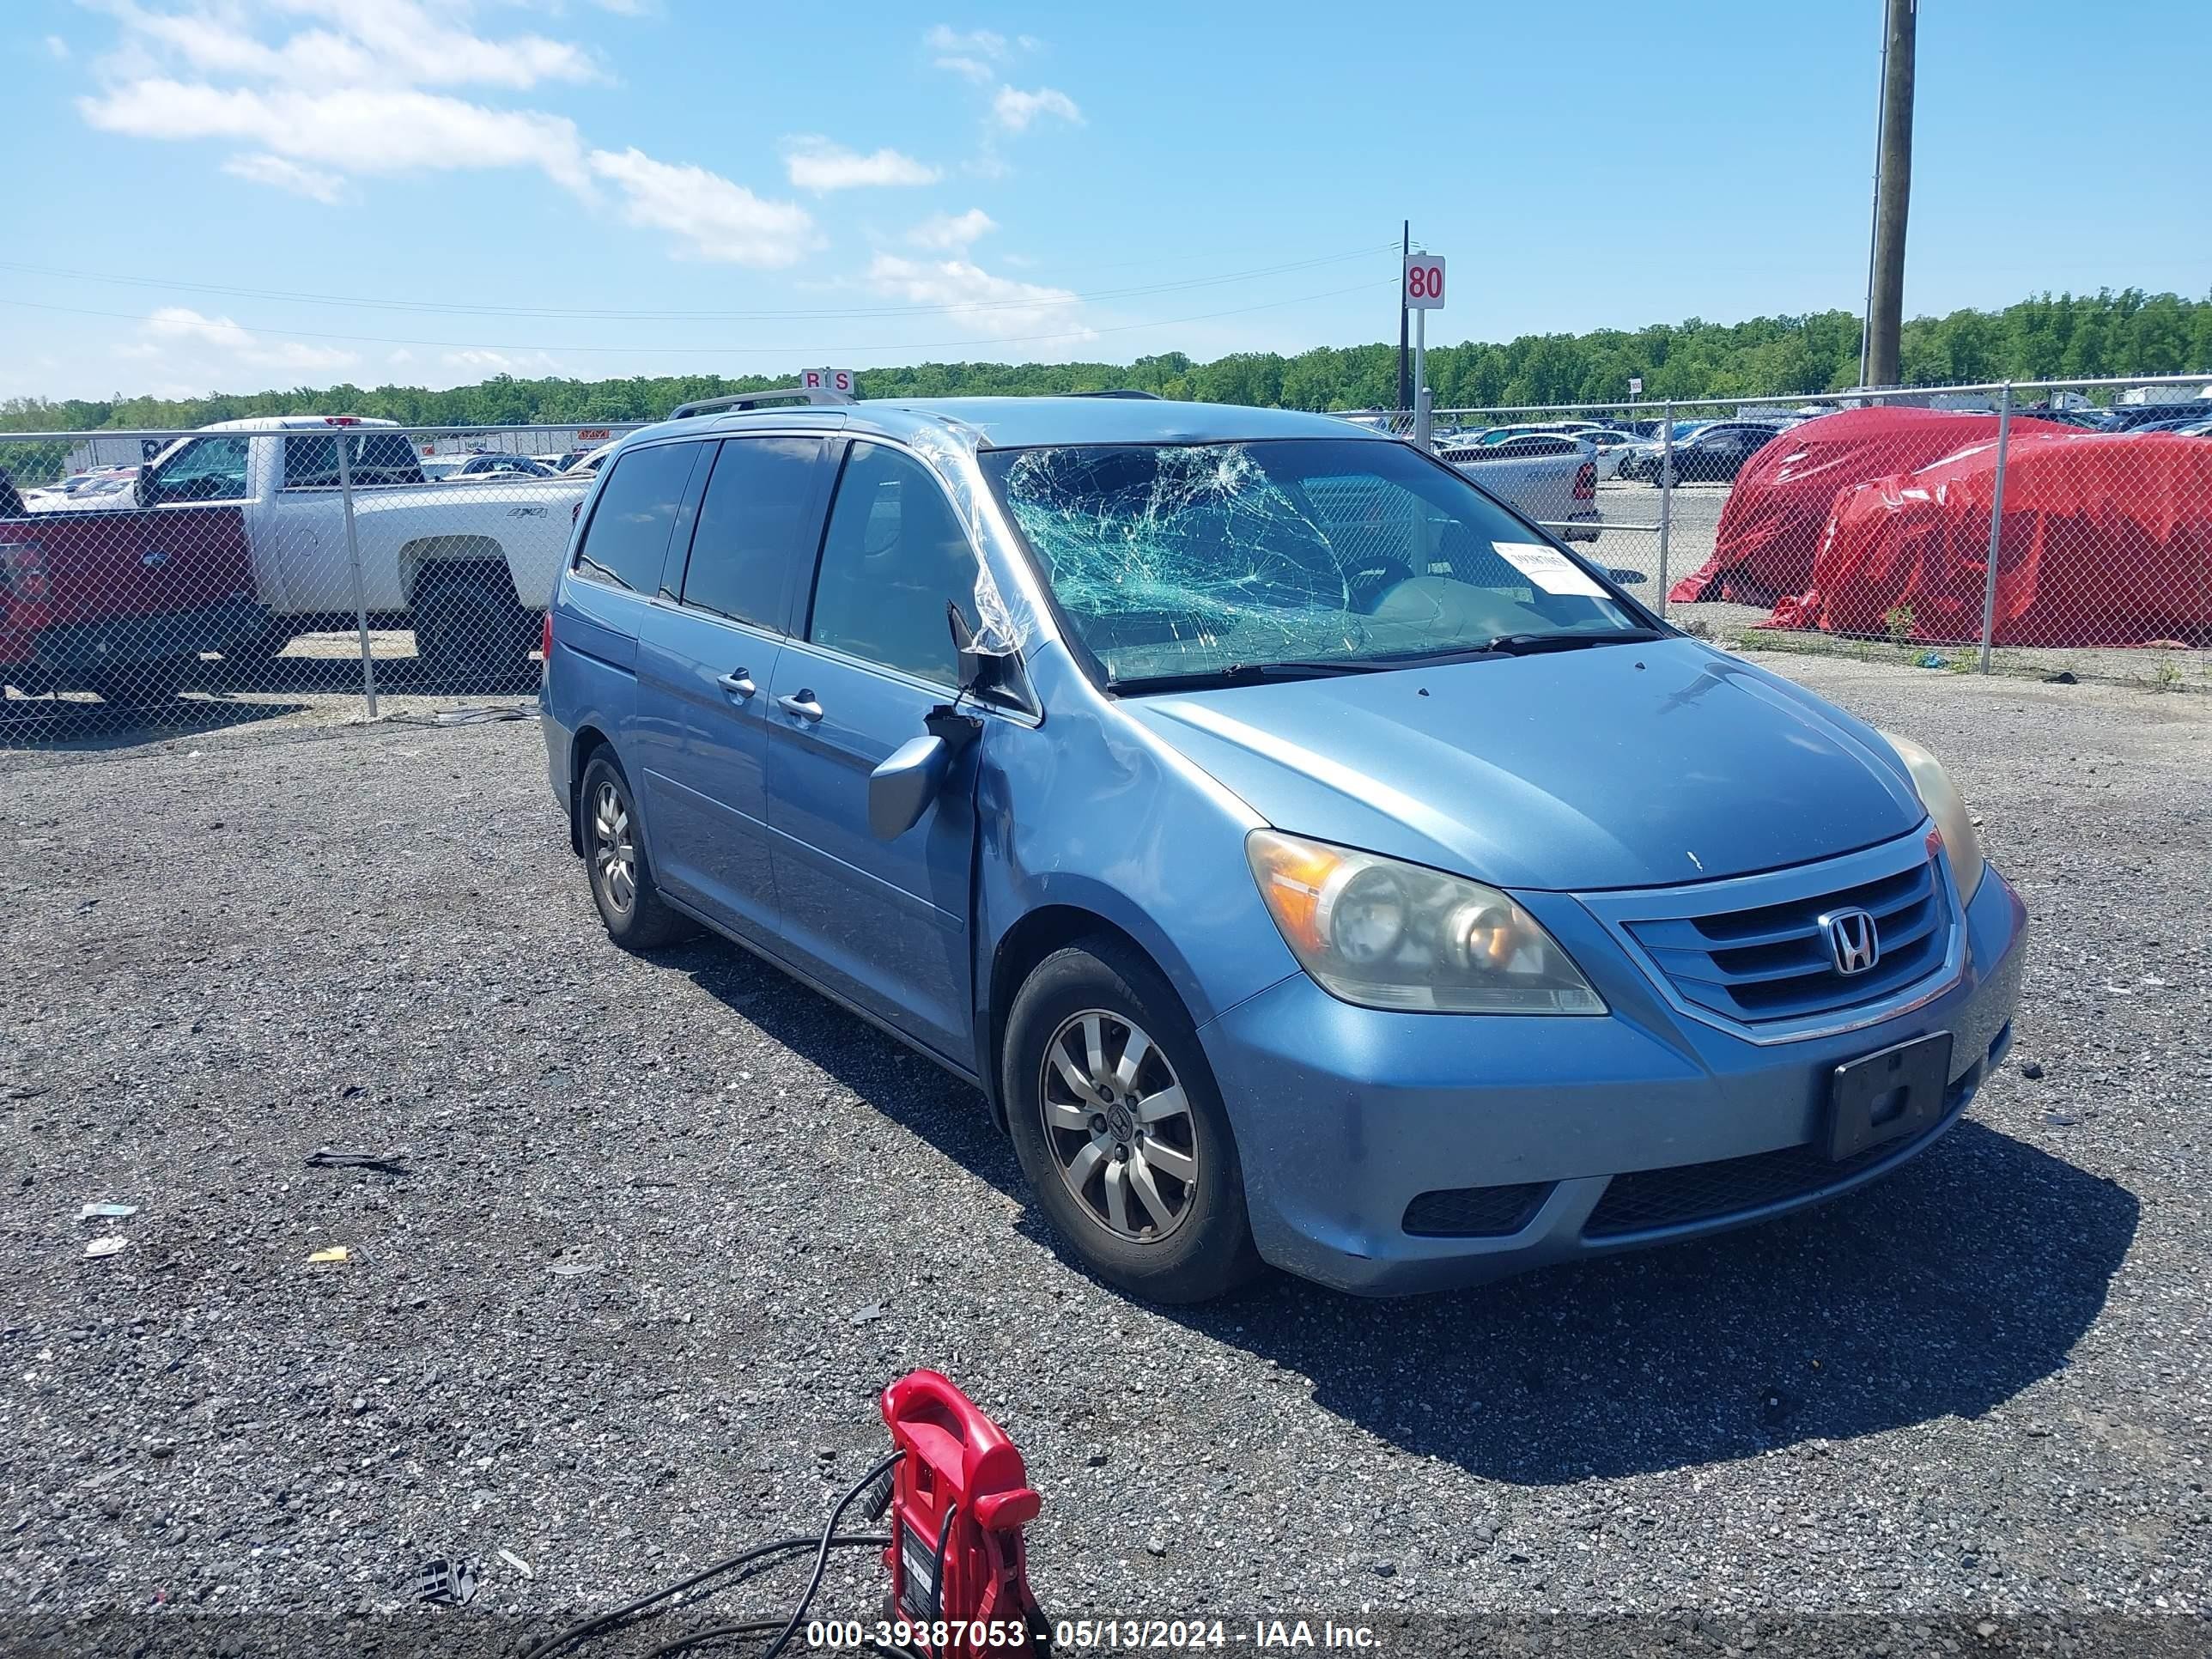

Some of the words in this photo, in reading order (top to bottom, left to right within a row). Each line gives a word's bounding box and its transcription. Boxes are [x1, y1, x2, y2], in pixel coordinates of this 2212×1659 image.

[1409, 266, 1443, 299] 80
[806, 373, 820, 388] R
[836, 373, 848, 390] S
